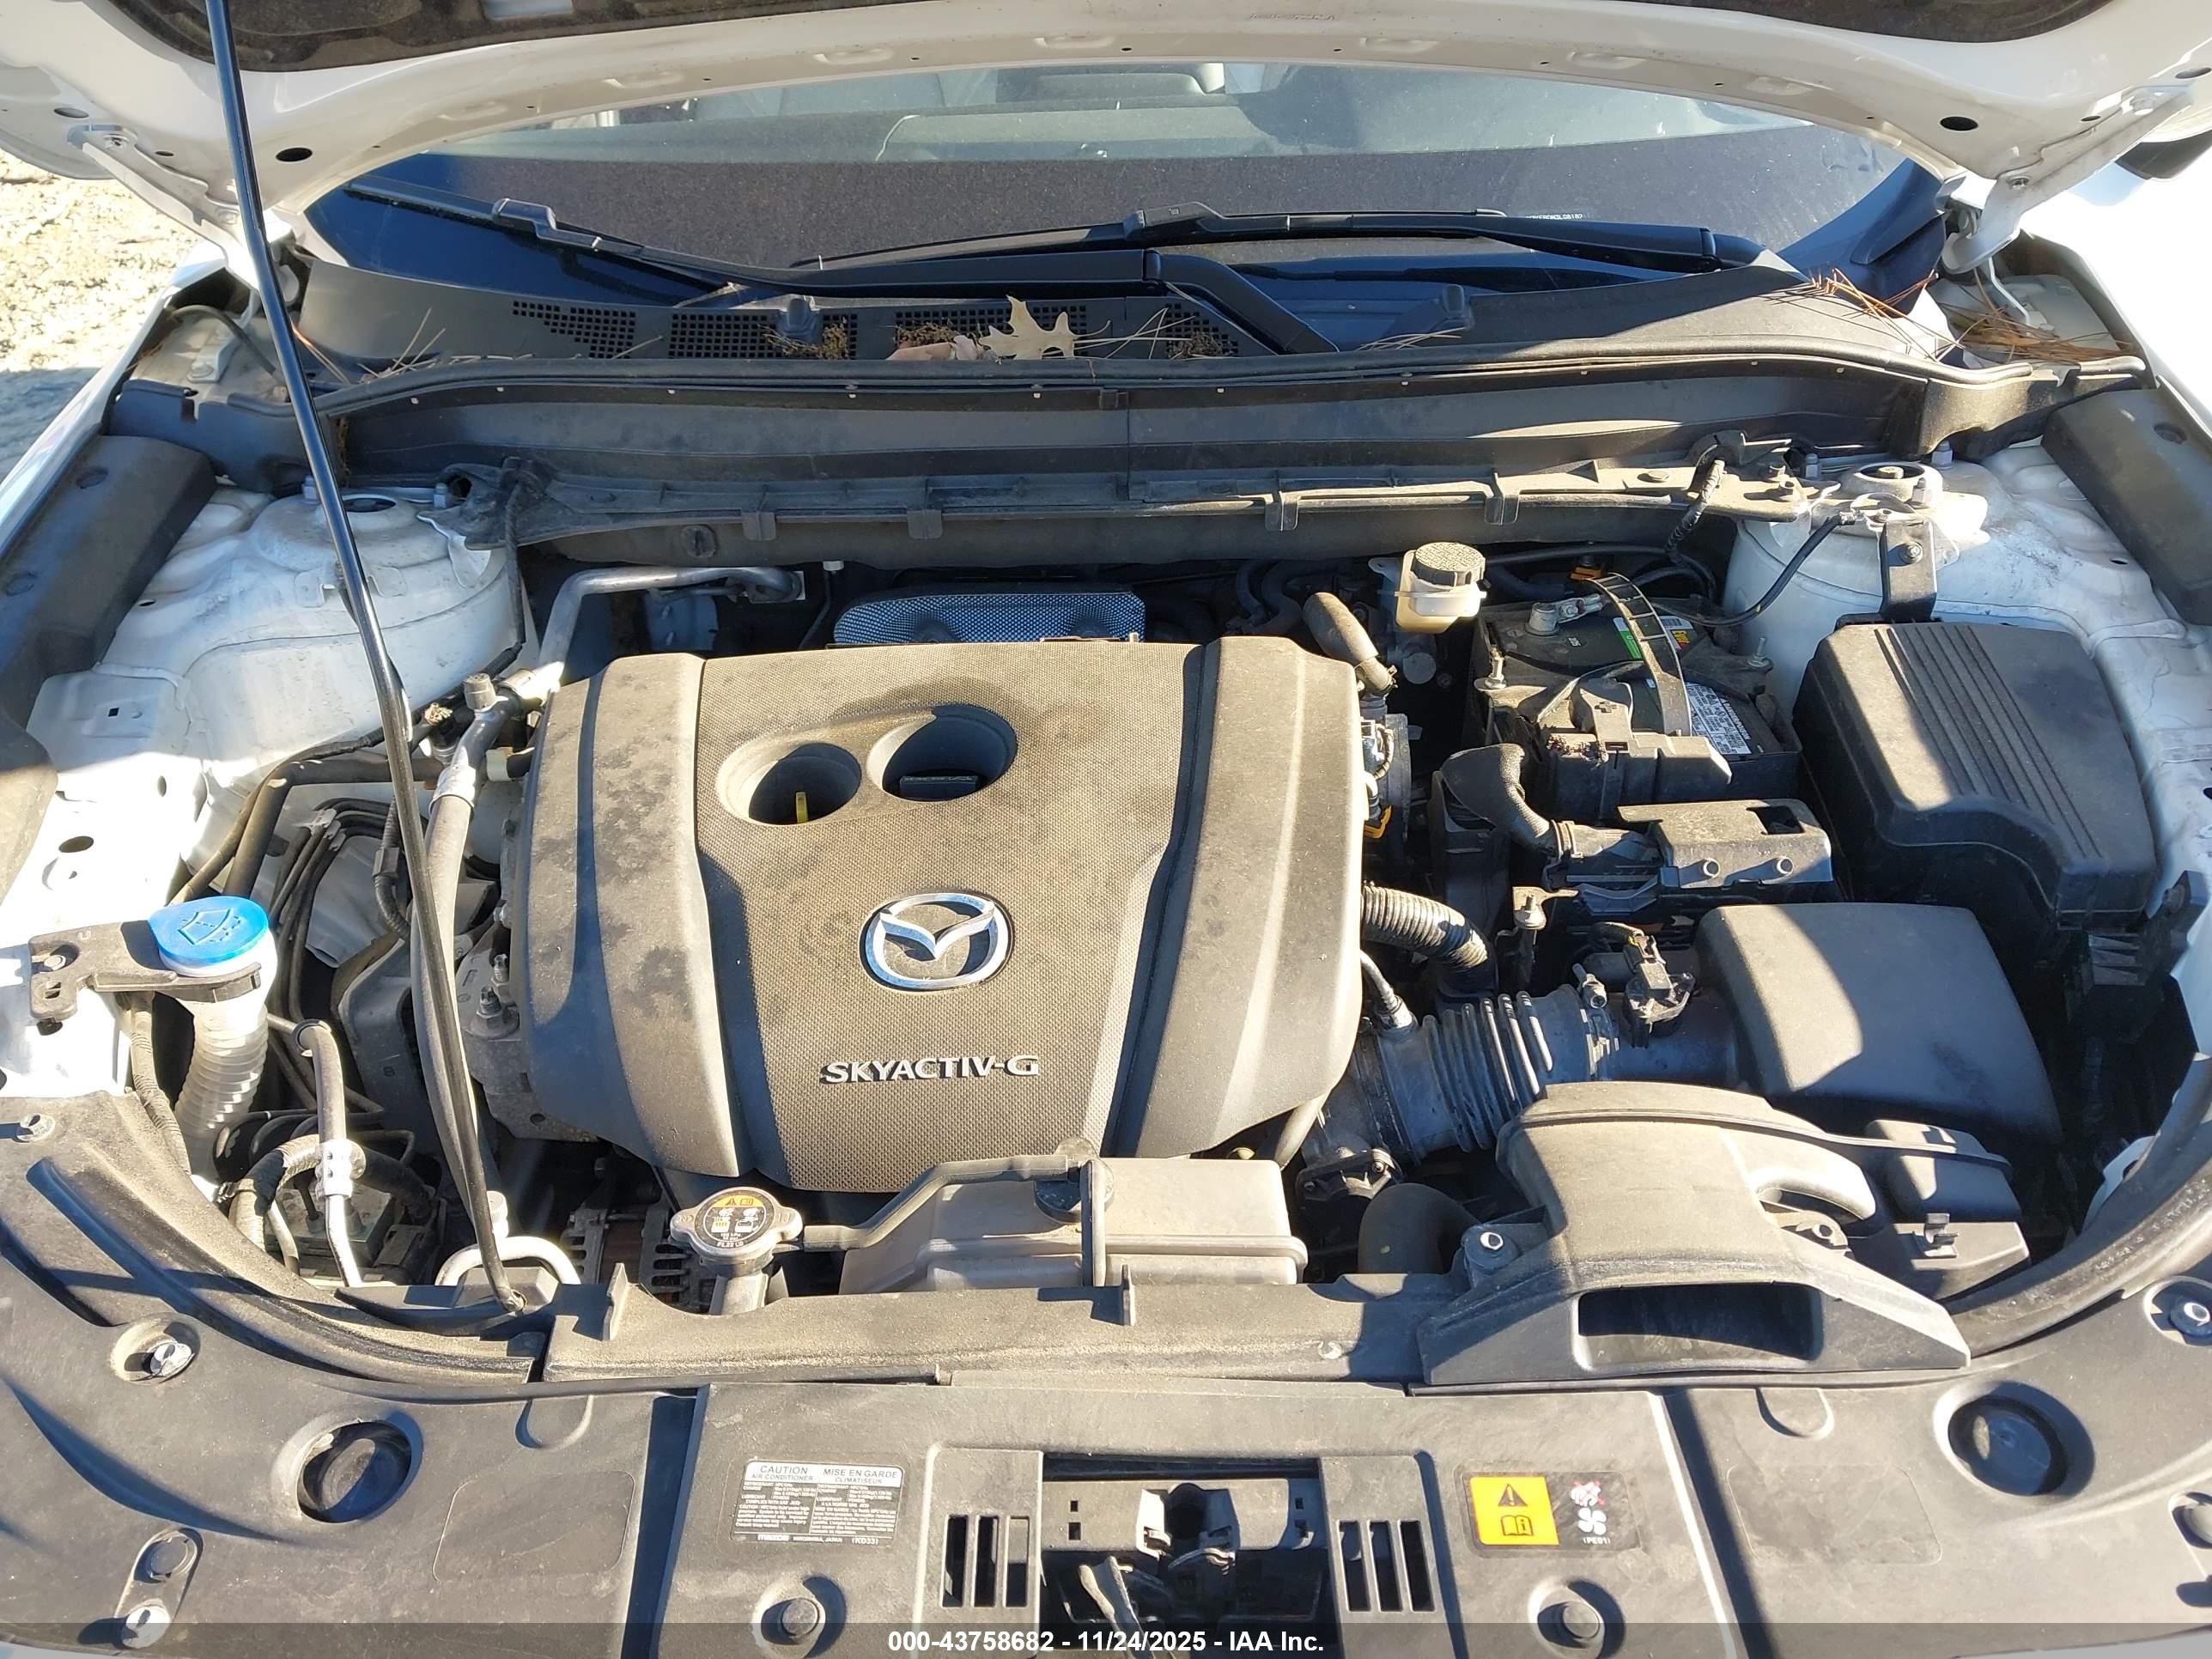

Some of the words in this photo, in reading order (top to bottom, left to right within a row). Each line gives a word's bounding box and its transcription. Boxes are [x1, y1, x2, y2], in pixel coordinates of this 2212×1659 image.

[821, 1054, 1039, 1084] SKYACTIV-G
[761, 1465, 808, 1474] CAUTION
[823, 1468, 846, 1477] MISE
[864, 1470, 898, 1479] GARDE
